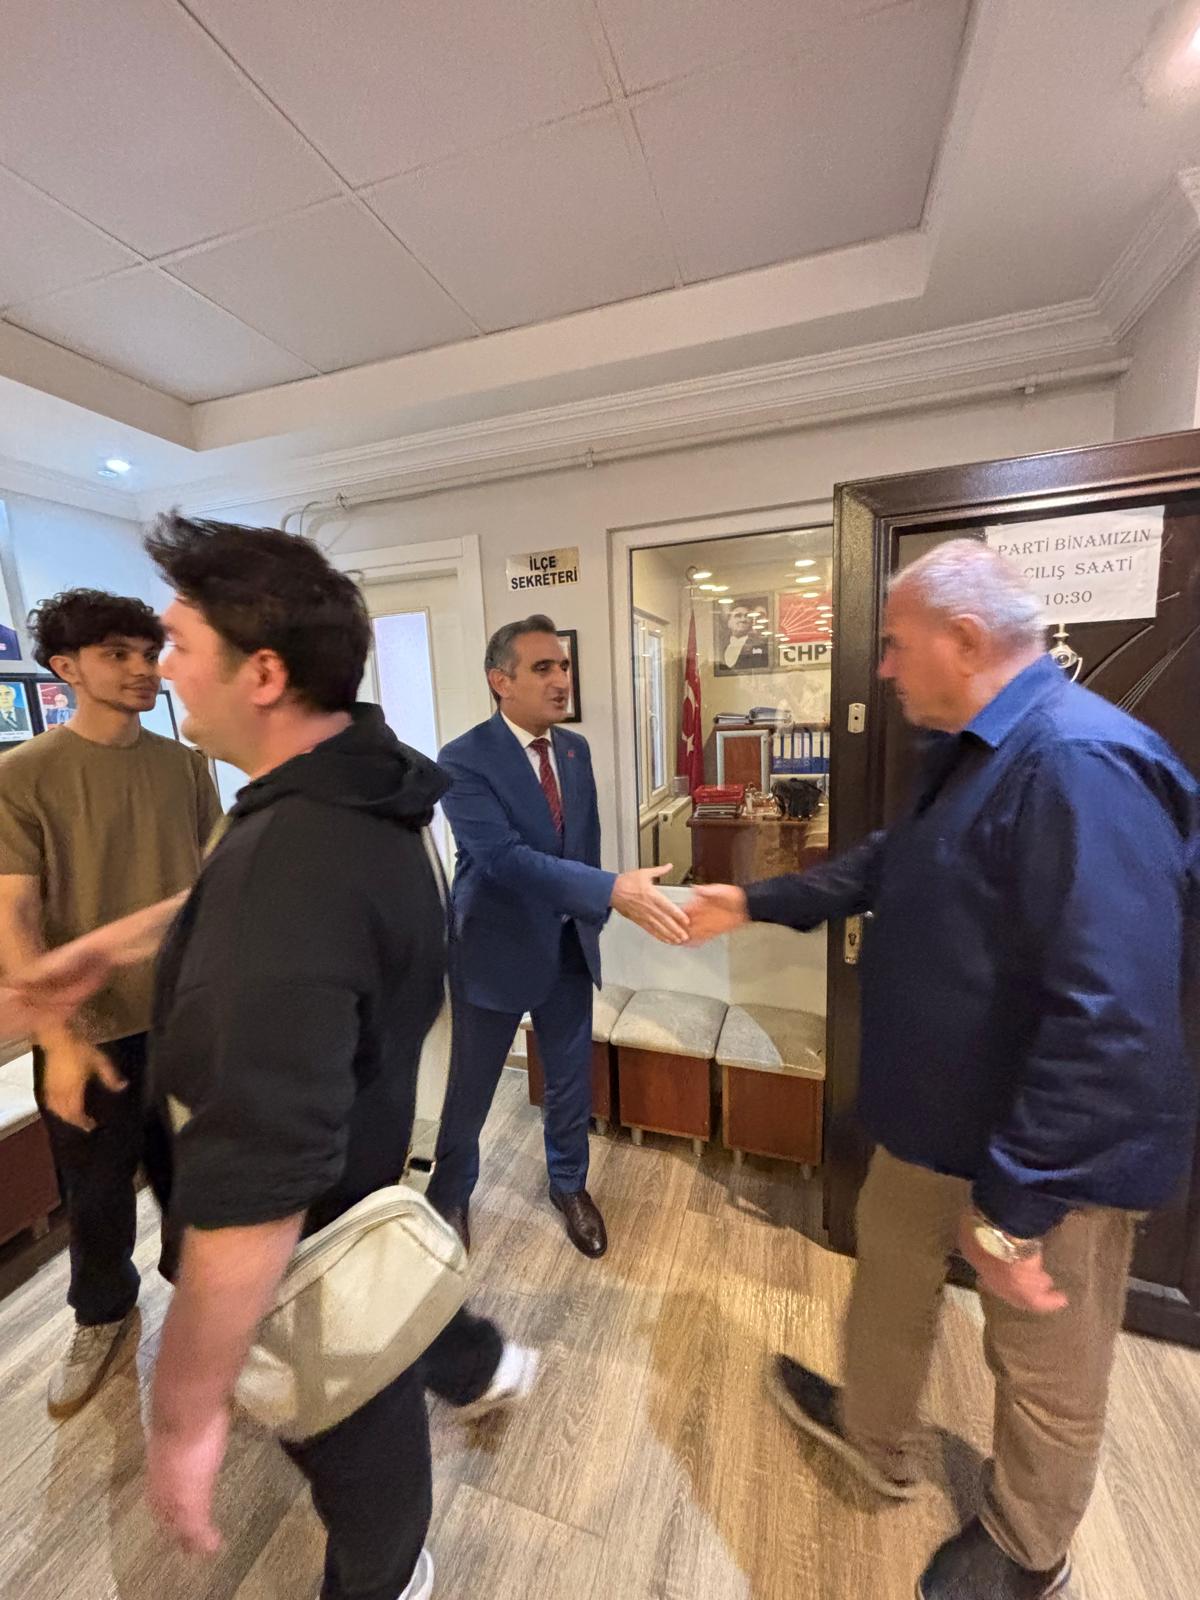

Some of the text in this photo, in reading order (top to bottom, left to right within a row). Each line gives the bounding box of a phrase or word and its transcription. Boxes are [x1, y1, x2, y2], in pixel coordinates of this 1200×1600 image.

[998, 528, 1152, 556] PARTİ BİNAMIZIN
[530, 555, 556, 572] İLÇE
[1074, 556, 1132, 576] SAATİ
[511, 567, 578, 589] SEKRETERİ
[1045, 590, 1092, 606] 10:30
[783, 644, 827, 662] CHP
